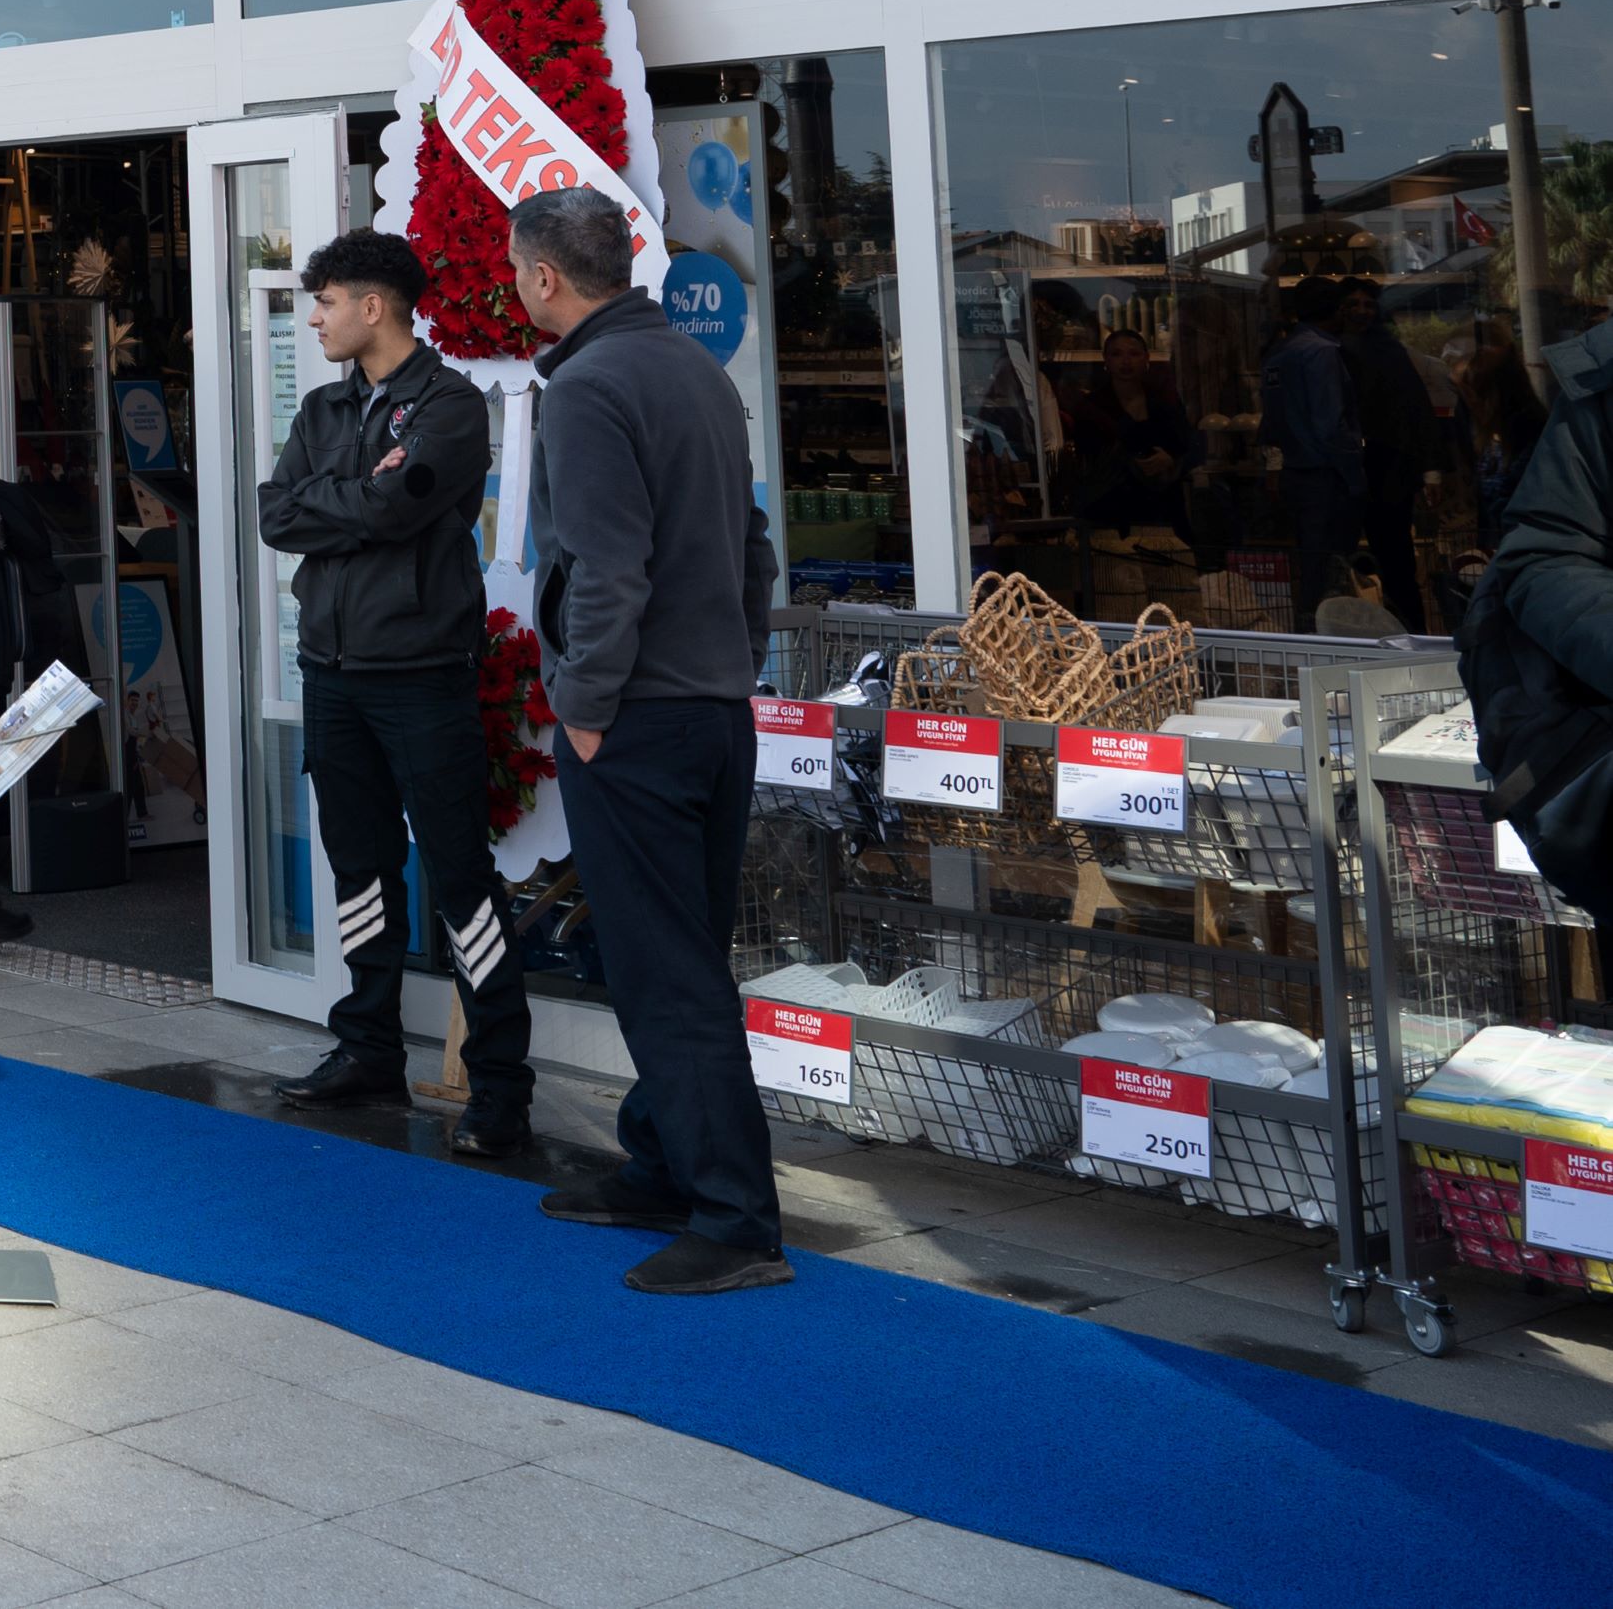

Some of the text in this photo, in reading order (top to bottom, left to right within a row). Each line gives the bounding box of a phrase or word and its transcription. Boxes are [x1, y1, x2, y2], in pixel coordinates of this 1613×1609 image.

[671, 283, 721, 312] %70
[672, 317, 725, 334] indirim
[758, 704, 804, 718] HER GÜN
[757, 715, 783, 725] UYGUN
[917, 719, 967, 733] HER GÜN
[917, 730, 944, 740] UYGUN
[1092, 736, 1148, 752] HER GÜN
[1092, 748, 1123, 759] UYGUN
[791, 757, 829, 775] 60TL
[940, 774, 995, 794] 400TL
[1119, 793, 1179, 815] 300TL
[775, 1009, 822, 1028] HER GÜN
[775, 1020, 800, 1032] UYGUN
[799, 1065, 847, 1087] 165TL
[1115, 1069, 1172, 1090] HER GÜN
[1115, 1082, 1147, 1095] UYGUN
[1145, 1133, 1206, 1159] 250TL
[1567, 1154, 1598, 1170] HER
[1568, 1168, 1606, 1183] UYGUN
